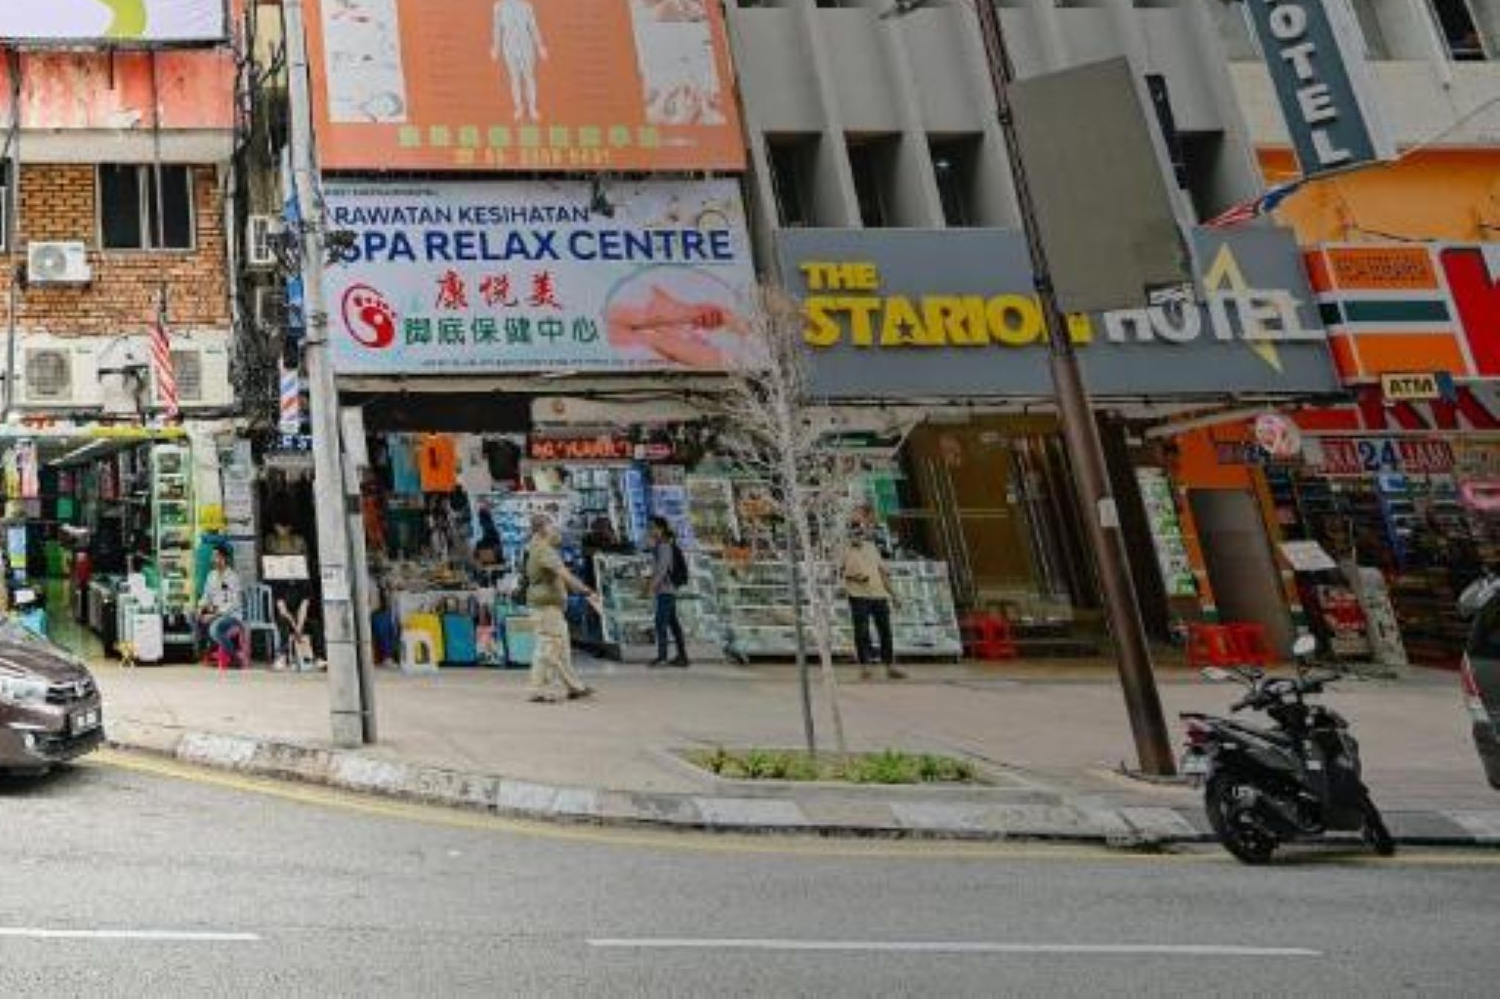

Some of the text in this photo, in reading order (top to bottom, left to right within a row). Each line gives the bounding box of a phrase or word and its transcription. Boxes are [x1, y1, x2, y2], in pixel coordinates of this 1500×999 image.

[334, 205, 590, 224] RAWATAN KESIHATAN
[424, 229, 561, 262] RELAX
[569, 229, 735, 261] CENTRE
[800, 262, 878, 291] THE
[1103, 287, 1327, 342] HOTEL
[1389, 379, 1433, 394] ATM
[1357, 440, 1398, 471] 24
